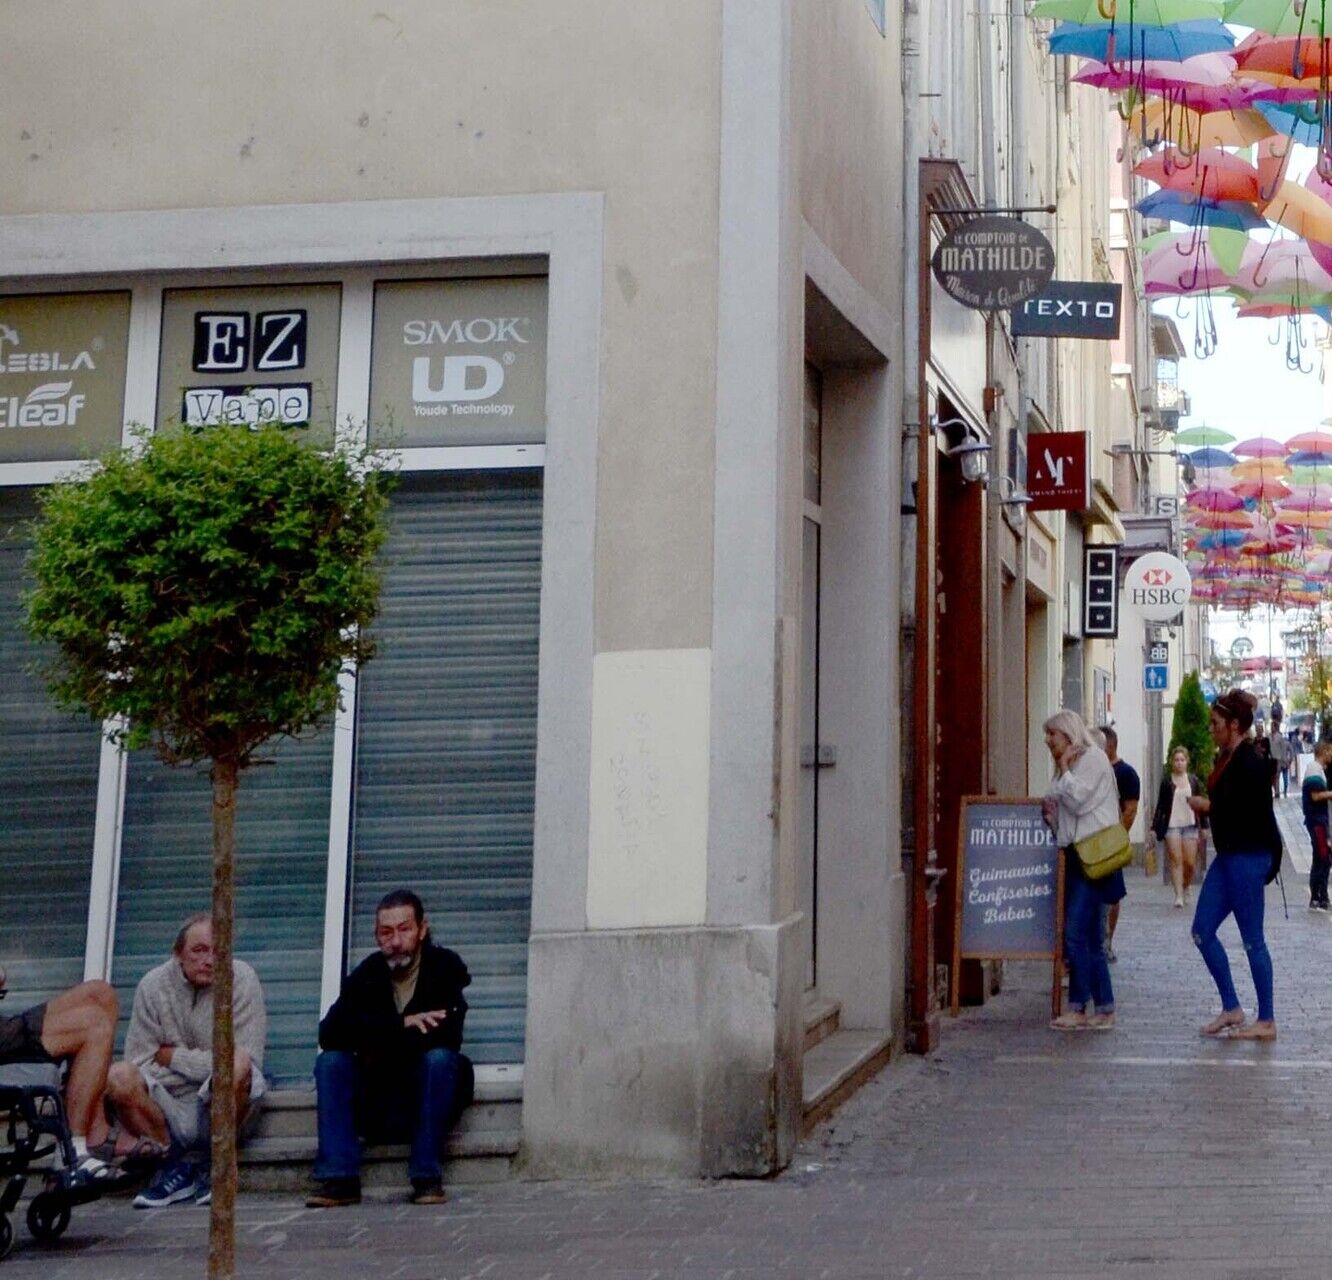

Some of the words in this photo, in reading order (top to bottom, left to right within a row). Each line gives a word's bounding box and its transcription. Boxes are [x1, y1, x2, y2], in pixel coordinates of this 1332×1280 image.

[964, 231, 1017, 245] COMPTOIR
[941, 246, 1047, 271] MATHILDE
[1024, 299, 1114, 318] TEXTO
[197, 314, 302, 369] EZ
[403, 317, 529, 345] SMOK
[412, 355, 504, 402] UD
[190, 392, 303, 426] Vape
[414, 405, 448, 416] Youde
[450, 403, 515, 416] Technology
[1133, 589, 1186, 605] HSBC
[970, 828, 1054, 846] MATHILDE
[969, 863, 1052, 888] Guimauves
[968, 884, 1051, 906] Confiseries
[983, 906, 1035, 924] Babas
